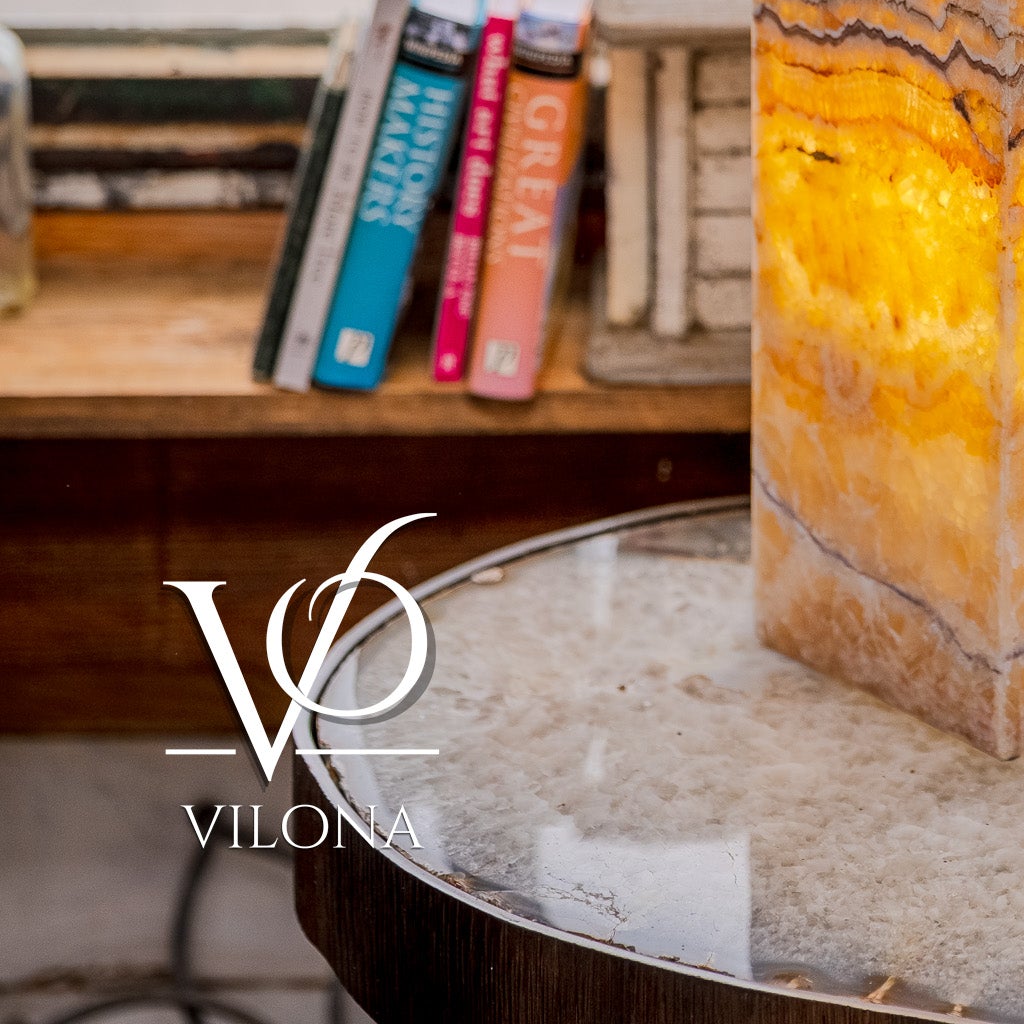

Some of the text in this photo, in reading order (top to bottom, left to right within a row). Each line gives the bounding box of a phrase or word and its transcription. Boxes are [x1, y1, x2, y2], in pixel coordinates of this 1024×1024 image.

[359, 75, 421, 226] MAKERS
[391, 85, 454, 234] HISTORY
[506, 93, 569, 264] GREAT
